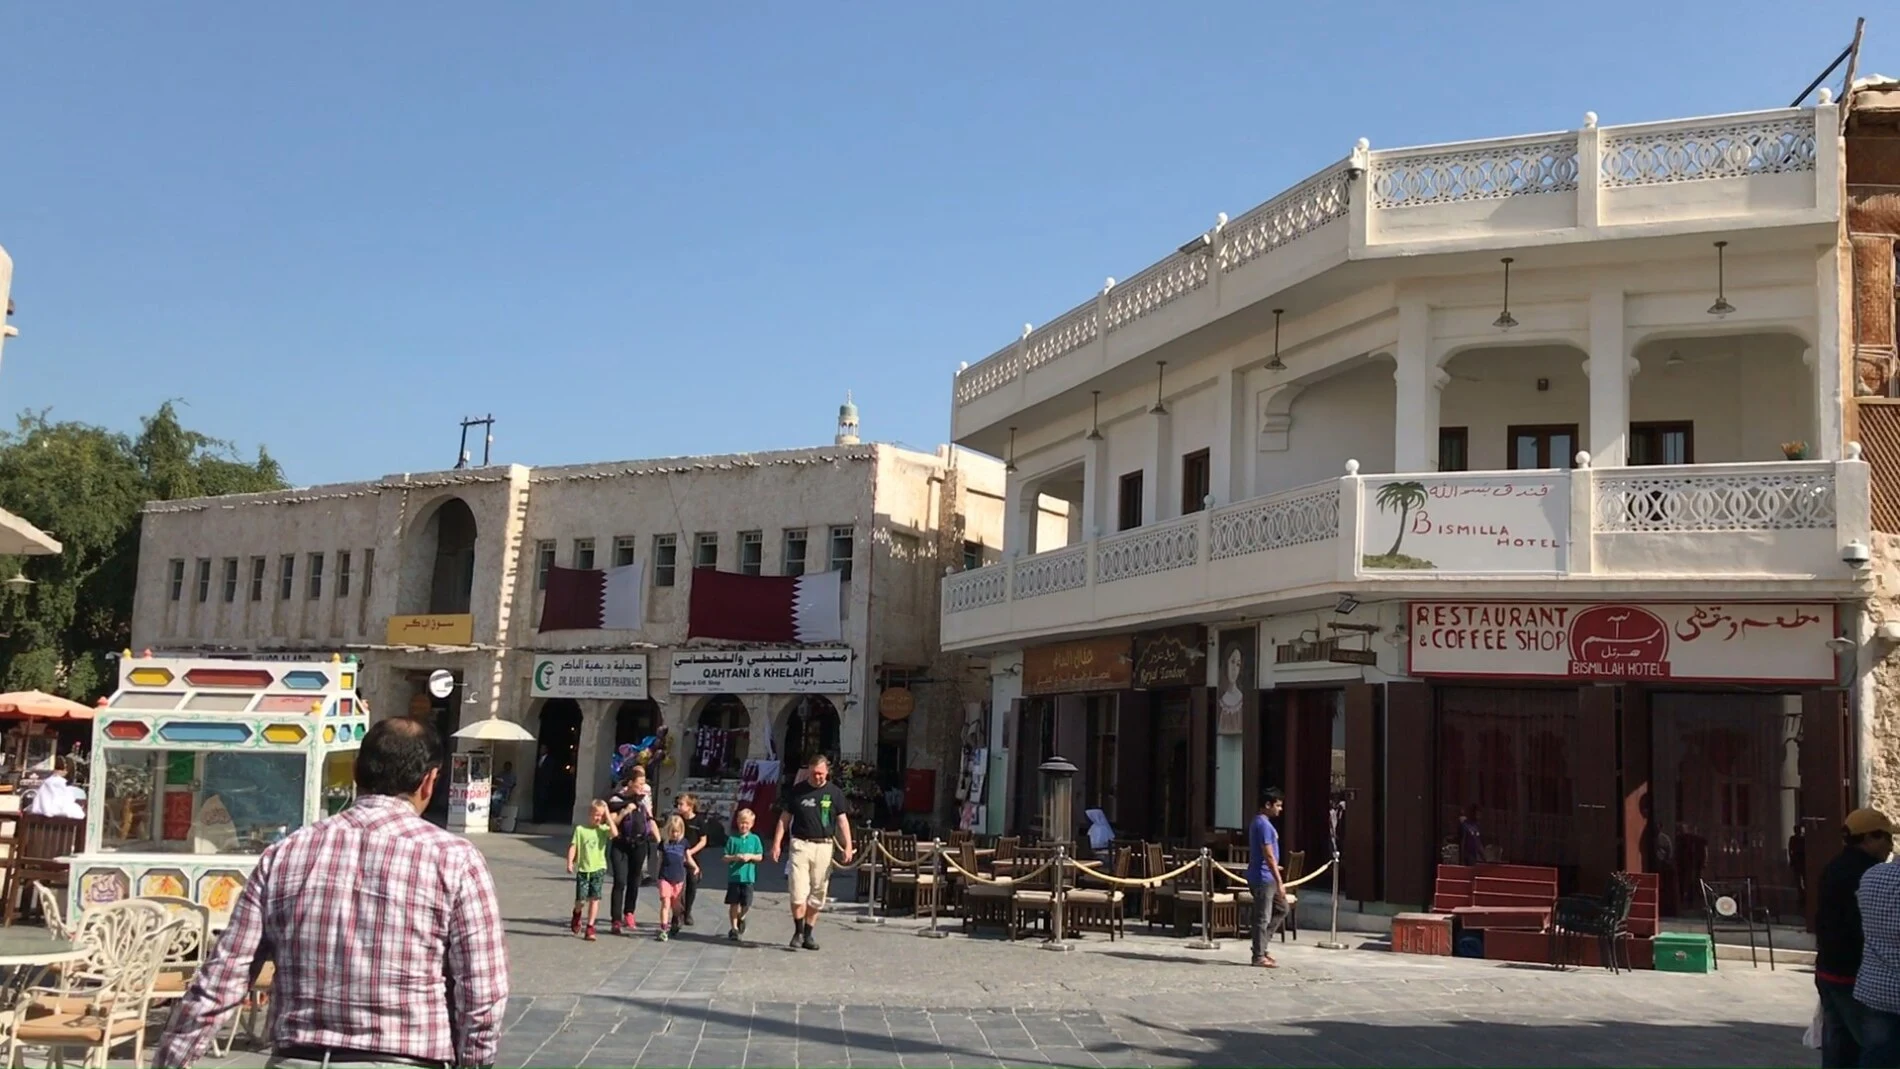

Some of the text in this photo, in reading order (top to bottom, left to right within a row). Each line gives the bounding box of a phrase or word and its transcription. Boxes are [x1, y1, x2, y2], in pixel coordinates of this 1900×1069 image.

[1411, 510, 1509, 535] BISMILLA
[1497, 538, 1561, 548] HOTEL
[1416, 605, 1569, 628] RESTAURANT
[1741, 607, 1820, 640] مطعم
[1419, 628, 1567, 651] & COFFEE SHOP
[703, 667, 814, 679] QAHTANI & KHELAIFI
[1572, 661, 1665, 676] BISMILLAH HOTEL
[612, 677, 642, 688] PHARMACY
[461, 787, 489, 800] repair
